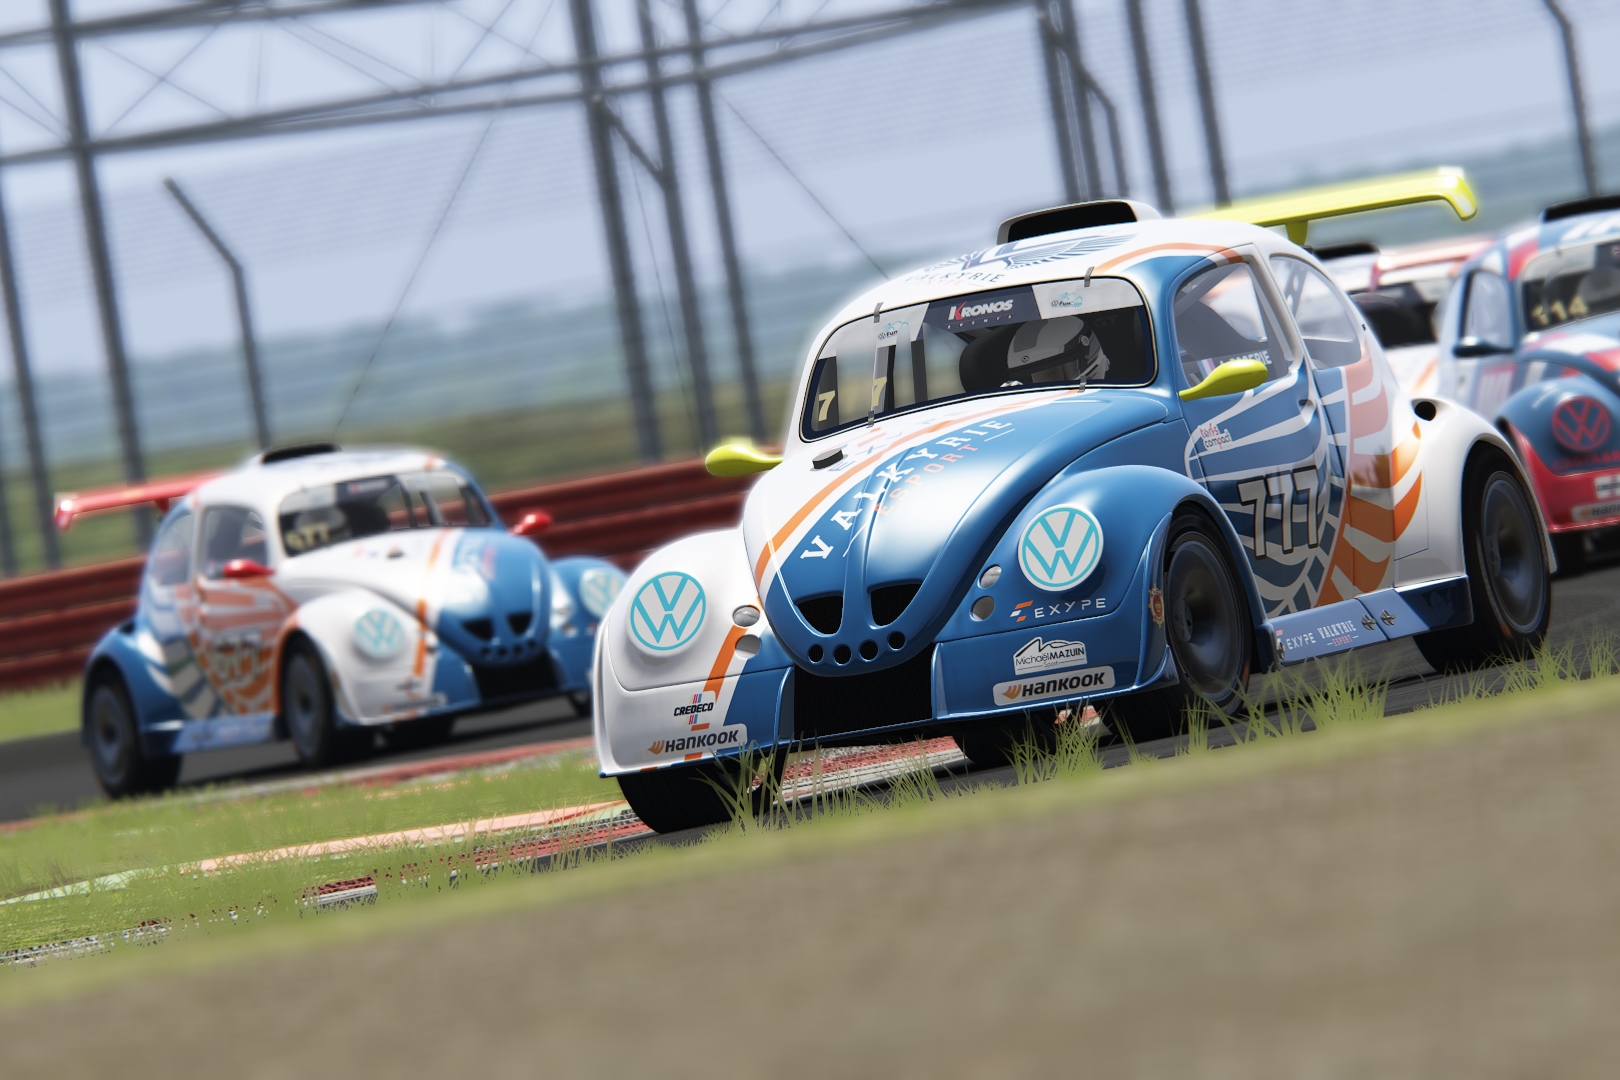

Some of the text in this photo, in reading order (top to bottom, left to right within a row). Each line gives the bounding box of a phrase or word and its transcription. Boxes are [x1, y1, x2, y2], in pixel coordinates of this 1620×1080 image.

[947, 300, 1013, 321] KRONOS
[800, 420, 1012, 559] VALKYRIE
[874, 443, 979, 516] ESPORT
[1237, 465, 1319, 560] 777
[1034, 598, 1106, 619] EXYPE
[1317, 620, 1357, 639] VALKYRIE
[1286, 632, 1317, 650] EXYPE
[1332, 634, 1354, 647] ESPORT
[673, 702, 714, 716] CREDECO
